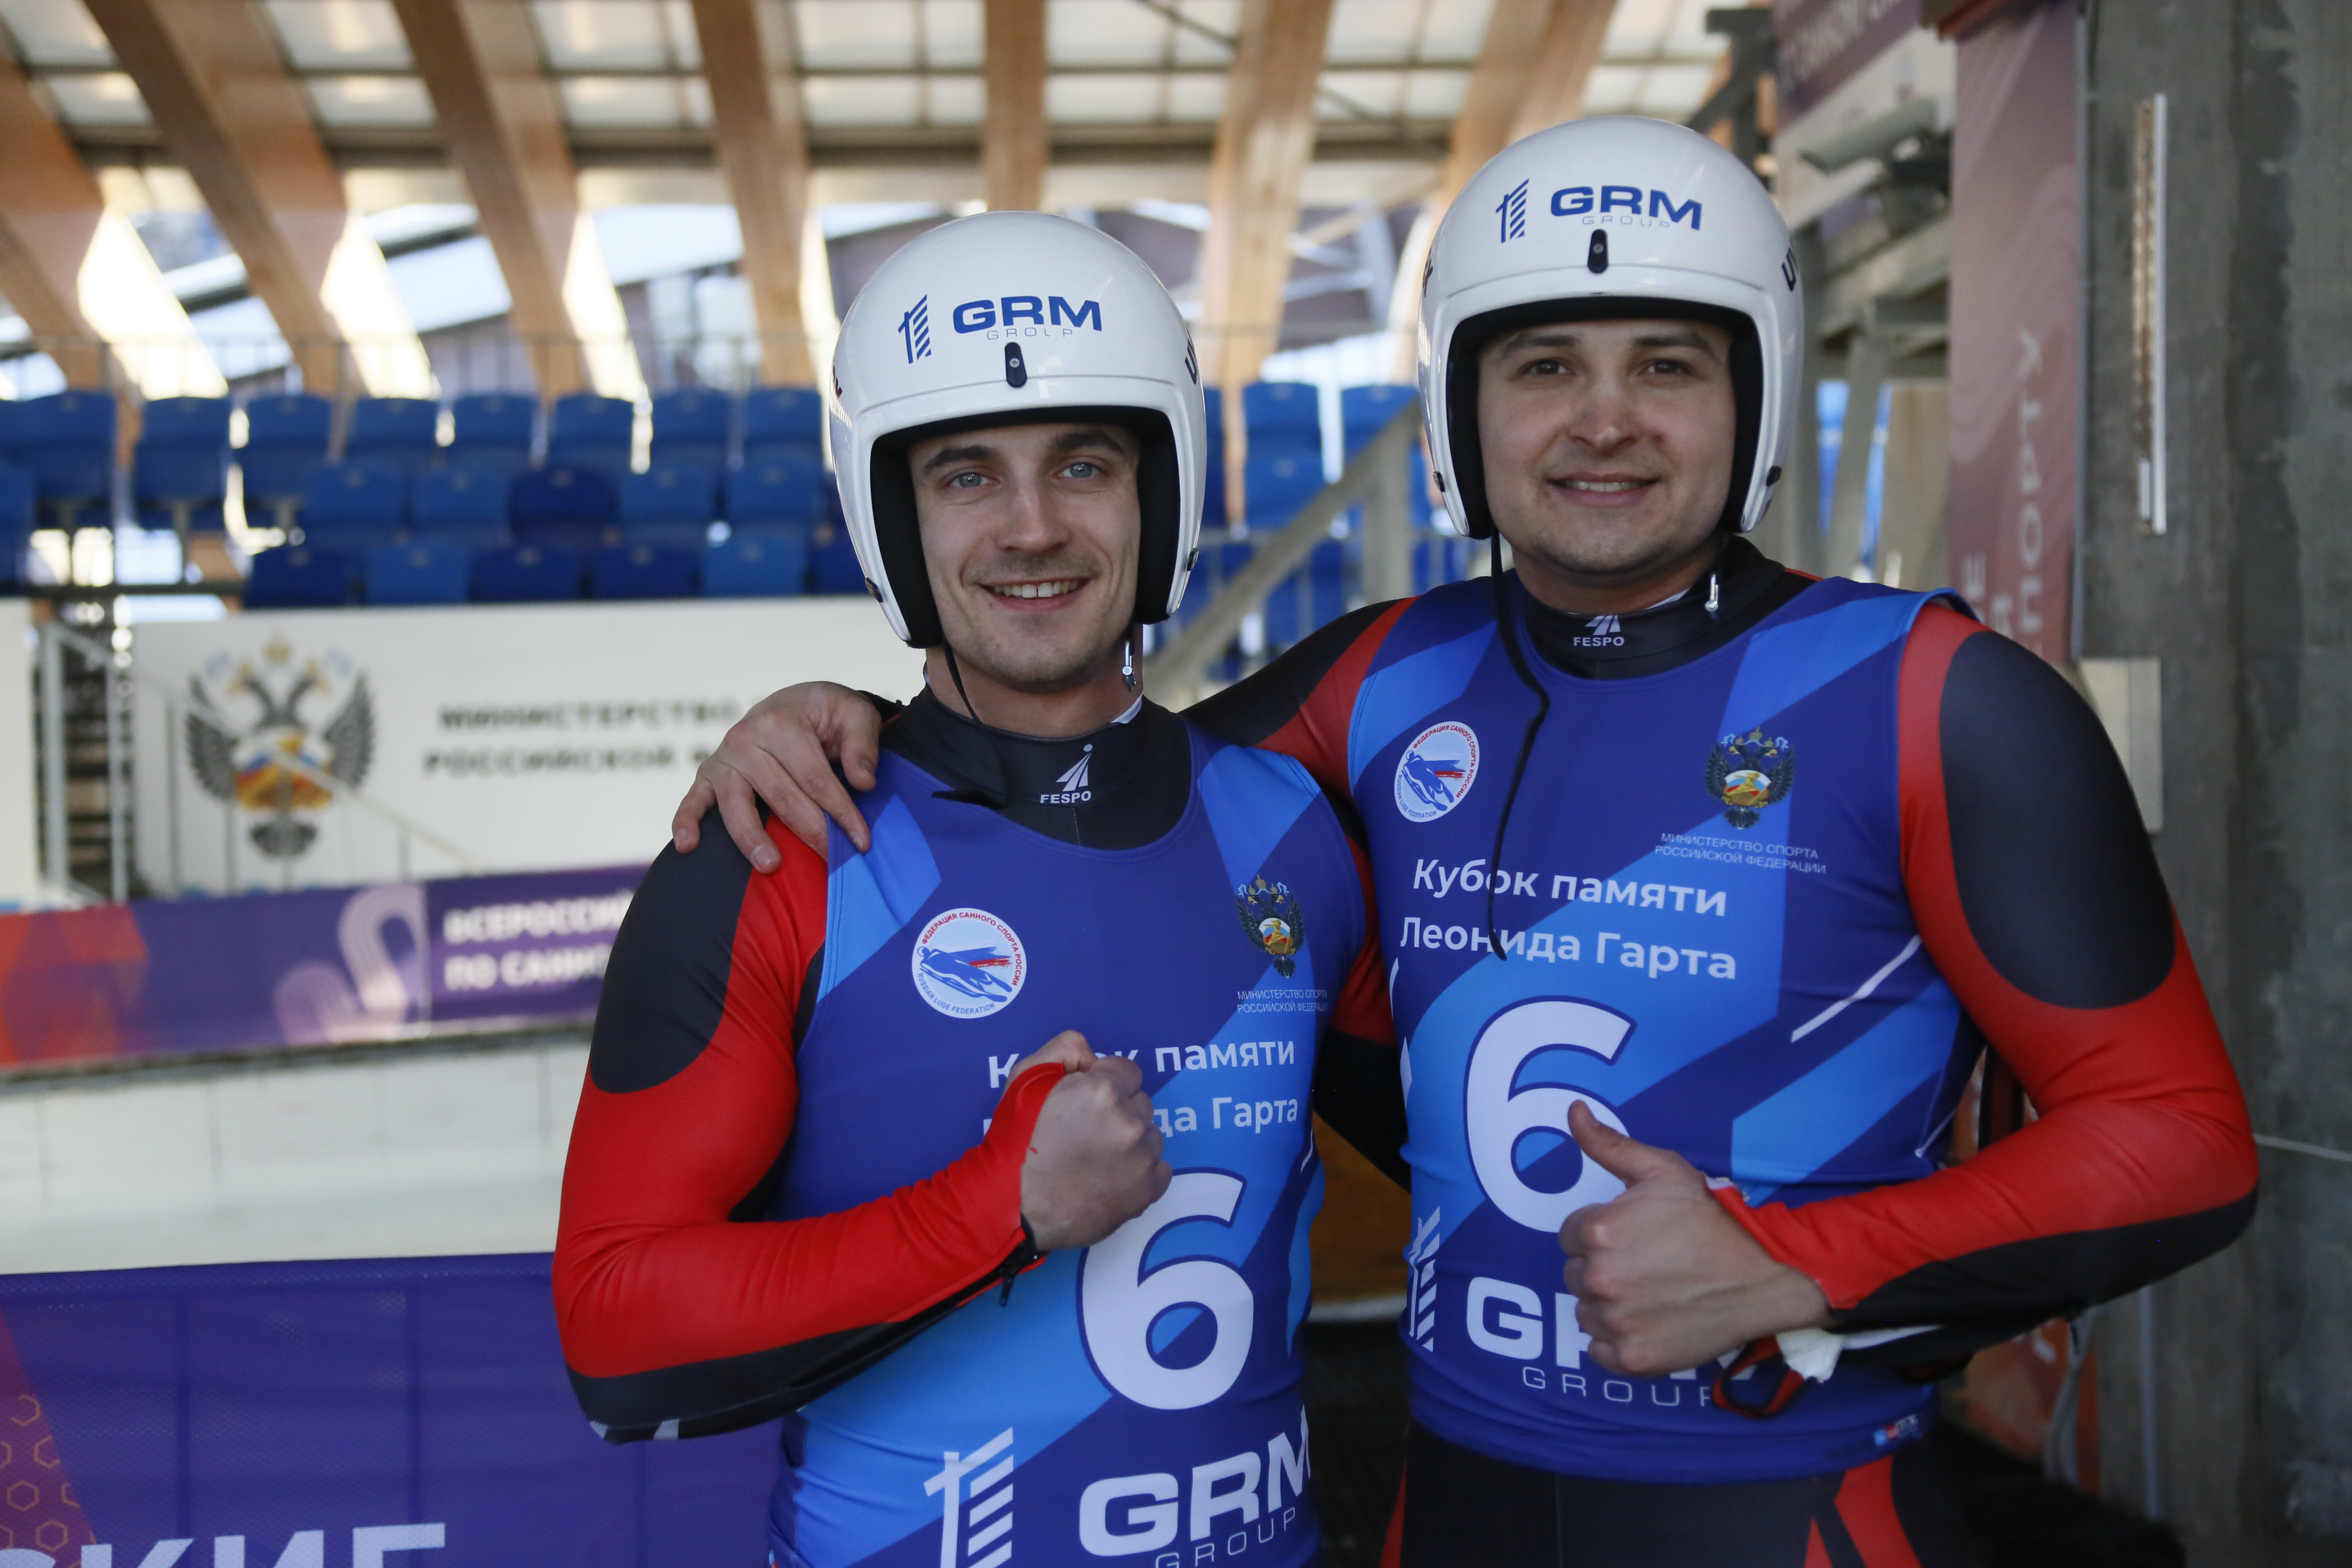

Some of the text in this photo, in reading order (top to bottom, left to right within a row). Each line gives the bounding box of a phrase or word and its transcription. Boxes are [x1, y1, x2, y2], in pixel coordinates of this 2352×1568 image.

[1551, 185, 1702, 230] GRM
[1582, 215, 1670, 228] GROUP
[953, 296, 1102, 334] GRM
[1573, 637, 1625, 646] FESPO
[1413, 725, 1450, 749] ФЕДЕРАЦИЯ
[1450, 725, 1472, 742] САННОГО
[1040, 791, 1091, 804] FESPO
[1456, 769, 1474, 798] РОССИИ
[1400, 800, 1409, 812] LUGE
[1408, 809, 1437, 818] FEDERATION
[1655, 845, 1826, 874] РОССИЙСКОЙ ФЕДЕРАЦИИ
[1661, 833, 1818, 859] МИНИСТЕРСТВО СПОРТА
[1413, 858, 1727, 917] Кубок памяти
[922, 912, 1022, 986] ФЕДЕРАЦИЯ САННОГО СПОРТА РОССИИ
[1400, 916, 1737, 980] Леонида Гарта
[917, 973, 996, 1015] RUSSIAN LUGE FEDERATION
[1237, 989, 1327, 1000] МИНИСТЕРСТВО СПОРТА
[1237, 1001, 1296, 1013] РОССИЙСКОЙ
[1155, 1040, 1295, 1073] памяти
[1212, 1096, 1298, 1134] Гарта
[1466, 1000, 1632, 1233] 6
[1082, 1172, 1254, 1410] 6
[1079, 1404, 1310, 1557] GRM
[1155, 1507, 1296, 1568] GROUP
